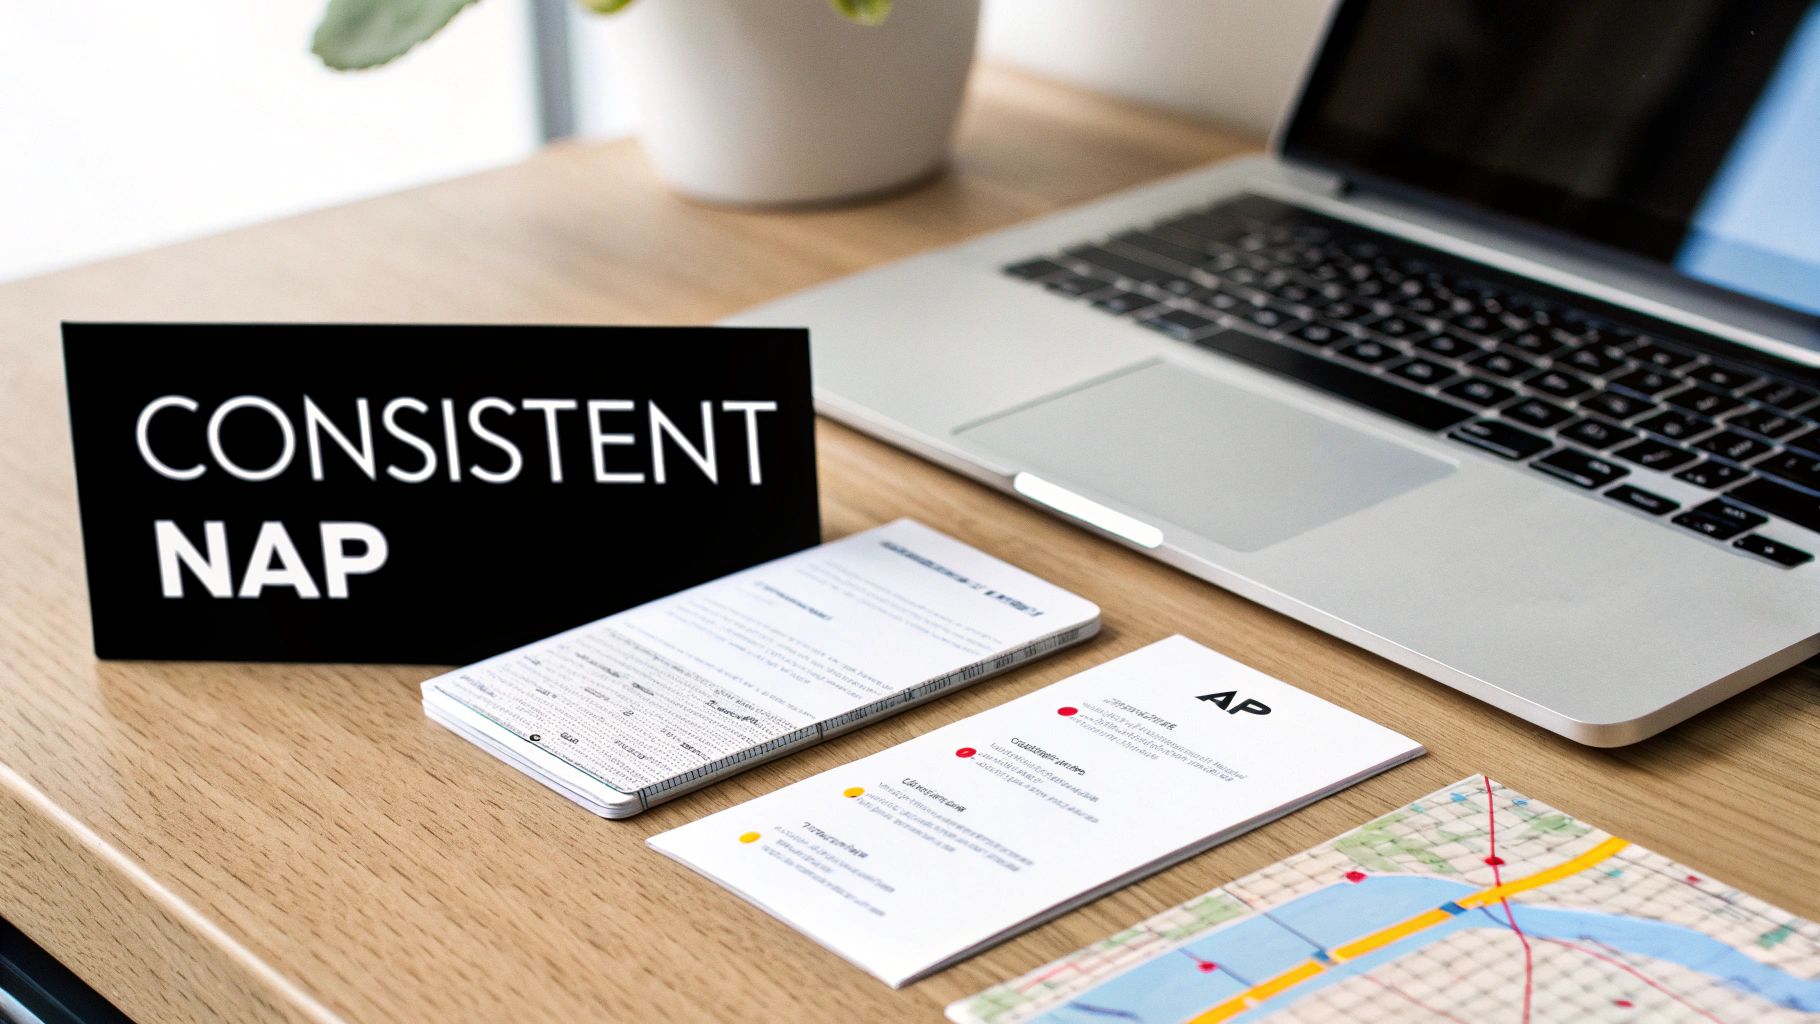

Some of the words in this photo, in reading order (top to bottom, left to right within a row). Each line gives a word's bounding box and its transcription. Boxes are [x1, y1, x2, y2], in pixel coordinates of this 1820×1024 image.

[136, 395, 778, 485] CONSISTENT
[154, 520, 388, 599] NAP
[1195, 690, 1272, 716] AP
